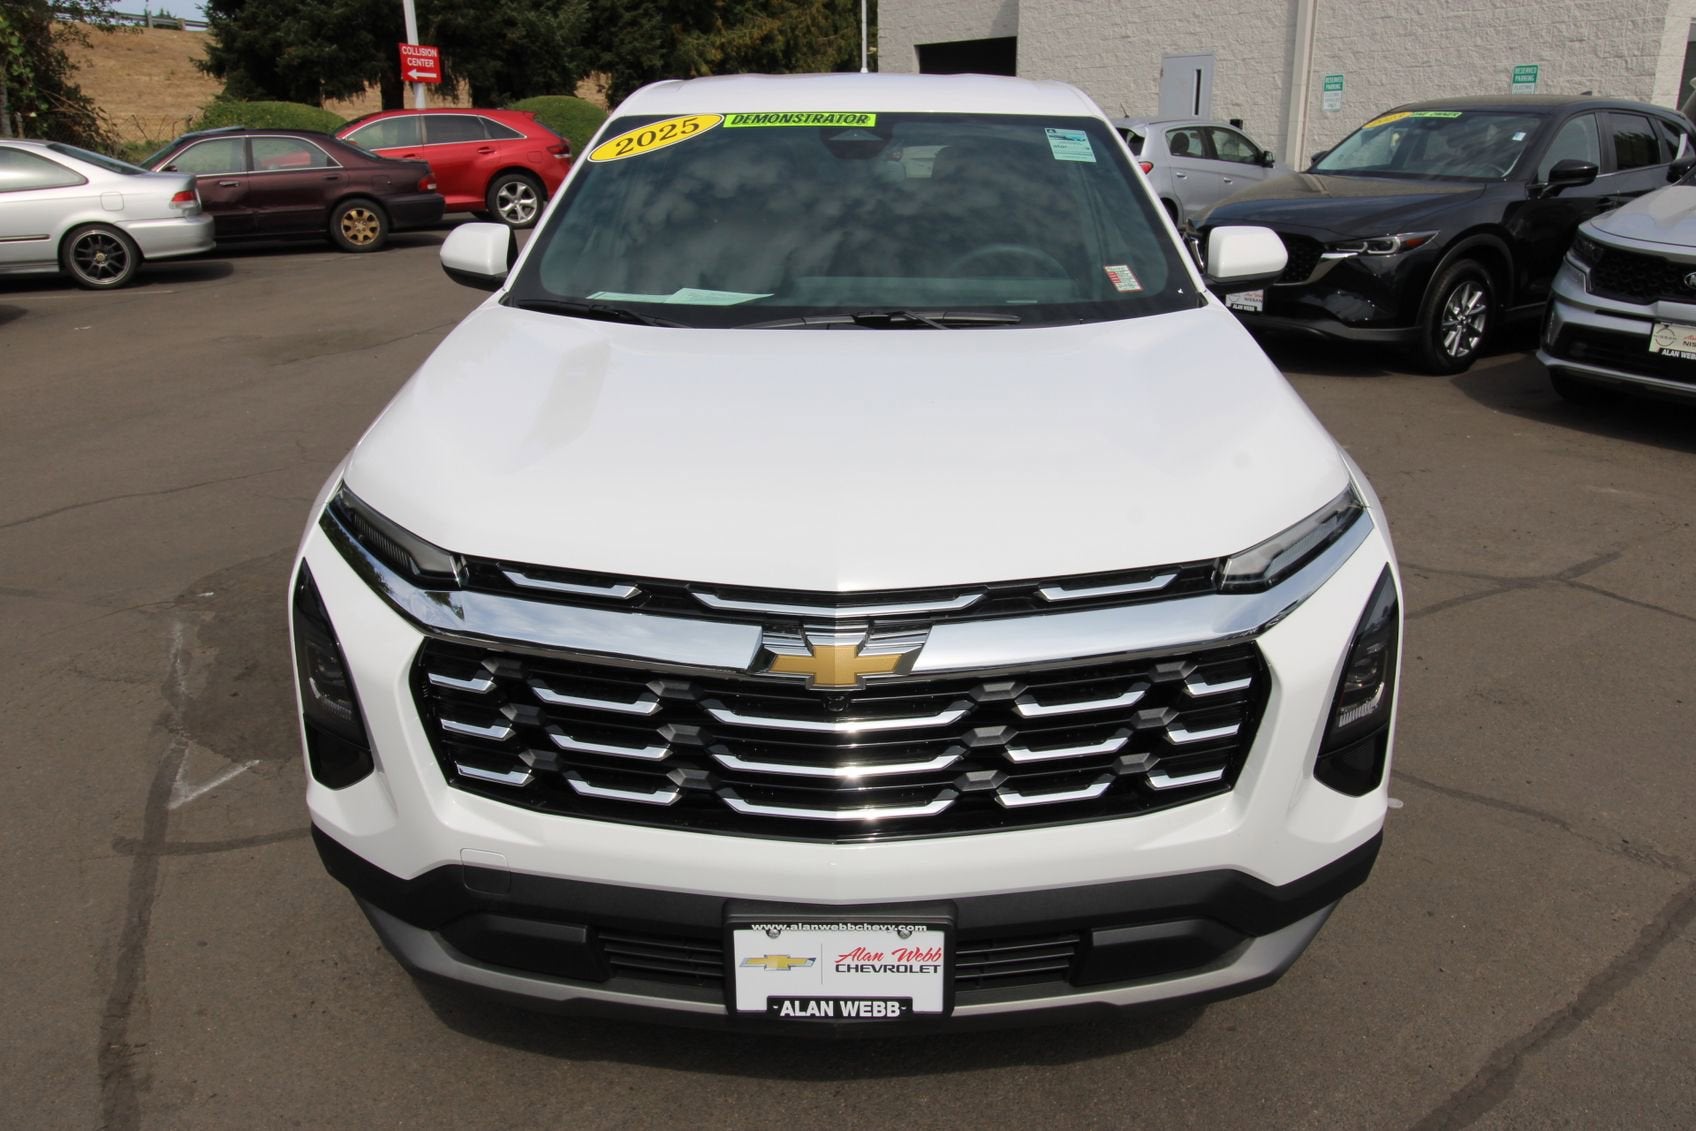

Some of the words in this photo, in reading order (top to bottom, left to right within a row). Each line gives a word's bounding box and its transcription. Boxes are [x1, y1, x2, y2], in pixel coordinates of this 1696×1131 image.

[402, 46, 437, 57] COLLISION
[407, 58, 434, 67] CENTER
[730, 113, 871, 125] DEMONSTRATOR
[615, 117, 700, 156] 2025
[1661, 349, 1680, 358] ALAN
[751, 923, 927, 932] www.alanwebbchevy.com
[835, 946, 884, 963] Alan
[891, 946, 943, 963] Webb
[834, 963, 941, 974] CHEVROLET
